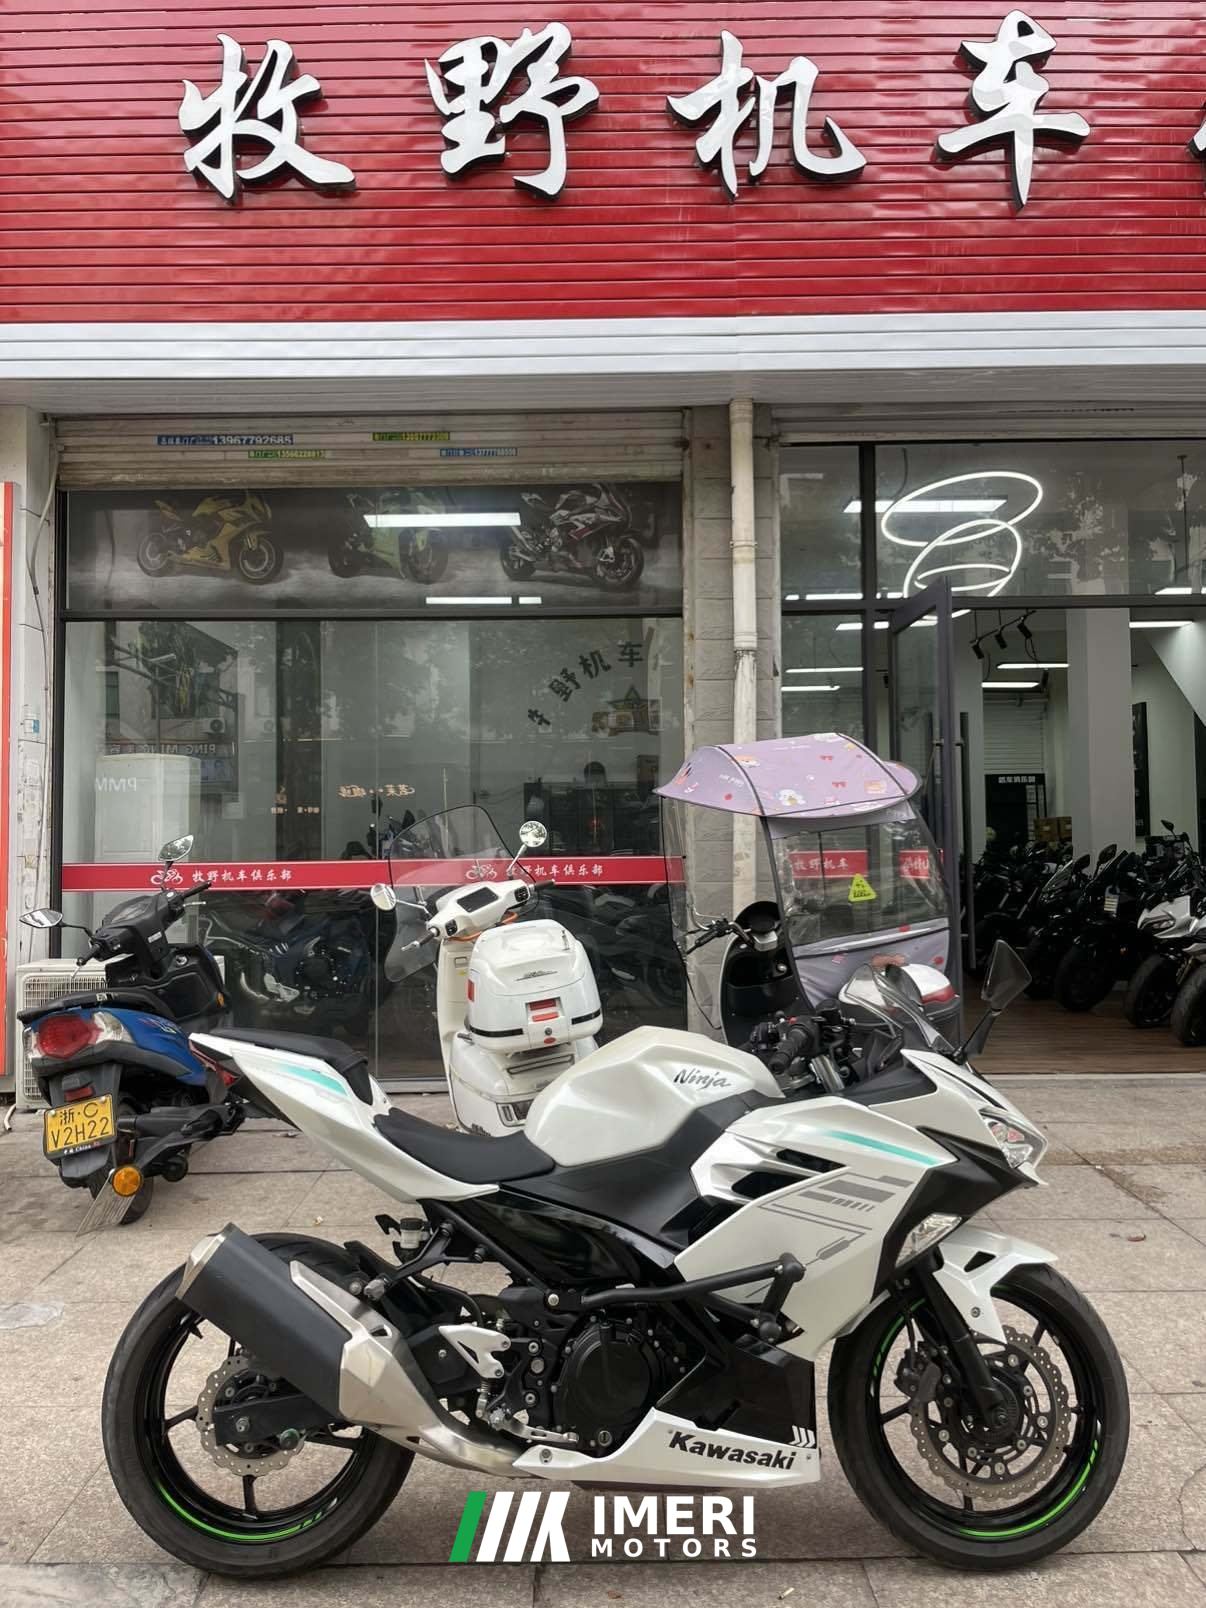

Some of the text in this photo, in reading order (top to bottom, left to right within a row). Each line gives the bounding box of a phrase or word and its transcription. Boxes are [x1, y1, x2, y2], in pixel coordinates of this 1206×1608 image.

[178, 9, 1206, 208] 牧野机车
[191, 868, 293, 883] 牧野机车俱乐部
[673, 1068, 732, 1090] Ninja
[51, 1116, 109, 1149] V2H22
[668, 1431, 797, 1470] Kawasaki
